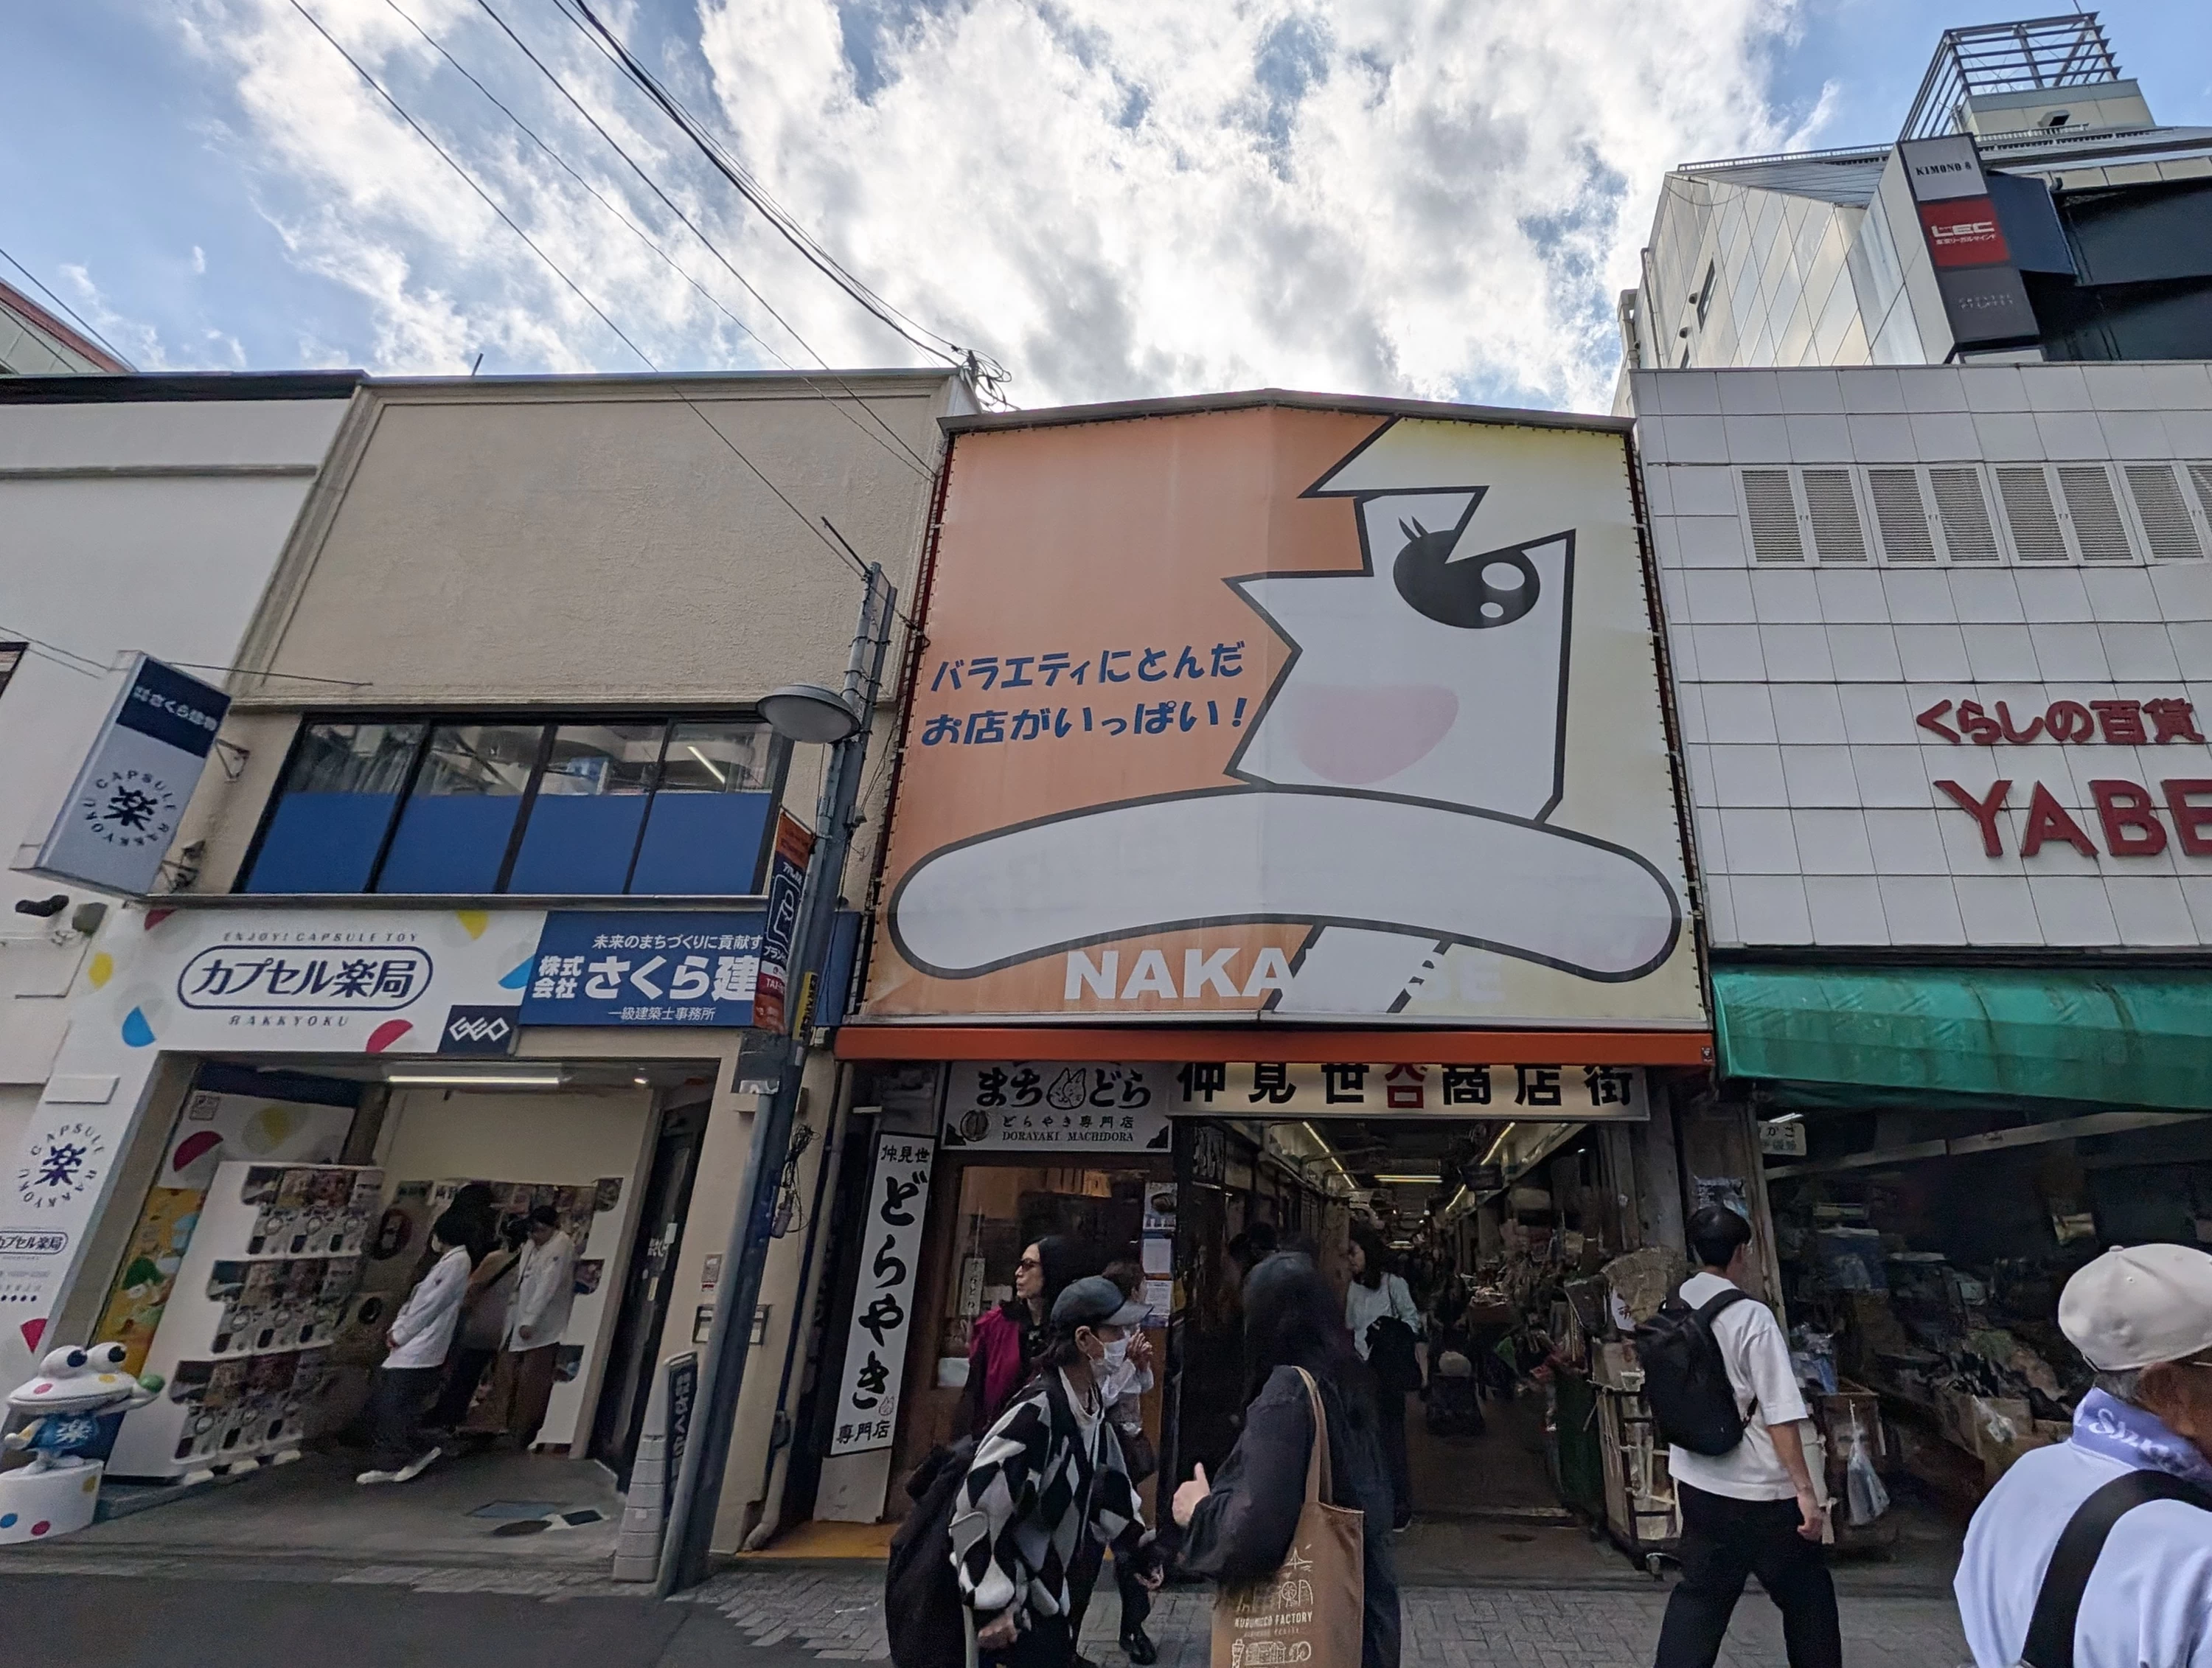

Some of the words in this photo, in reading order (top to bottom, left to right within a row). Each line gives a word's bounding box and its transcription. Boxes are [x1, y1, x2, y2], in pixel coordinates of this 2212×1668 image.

[1916, 161, 1963, 177] KIMONO
[1931, 221, 1995, 237] LEC
[931, 641, 1246, 692] バラエティにとんだ
[1933, 779, 2212, 858] YABE
[296, 932, 377, 943] CAPSULE
[385, 932, 418, 943] TOY
[190, 957, 418, 999] カプセル楽局
[228, 1014, 349, 1028] RAKKYOKU
[608, 1006, 716, 1021] 一級建築士事務所
[449, 1016, 509, 1041] GEO
[976, 1068, 1043, 1108] まち
[1088, 1069, 1152, 1108] どら
[1001, 1114, 1135, 1130] どらやき専門店
[1002, 1131, 1060, 1142] DORAYAKI
[1067, 1131, 1135, 1142] MACHIDORA
[881, 1144, 931, 1164] 仲見世
[852, 1170, 929, 1410] どらやき
[836, 1419, 891, 1445] 専門店
[1275, 1610, 1313, 1626] FACTORY
